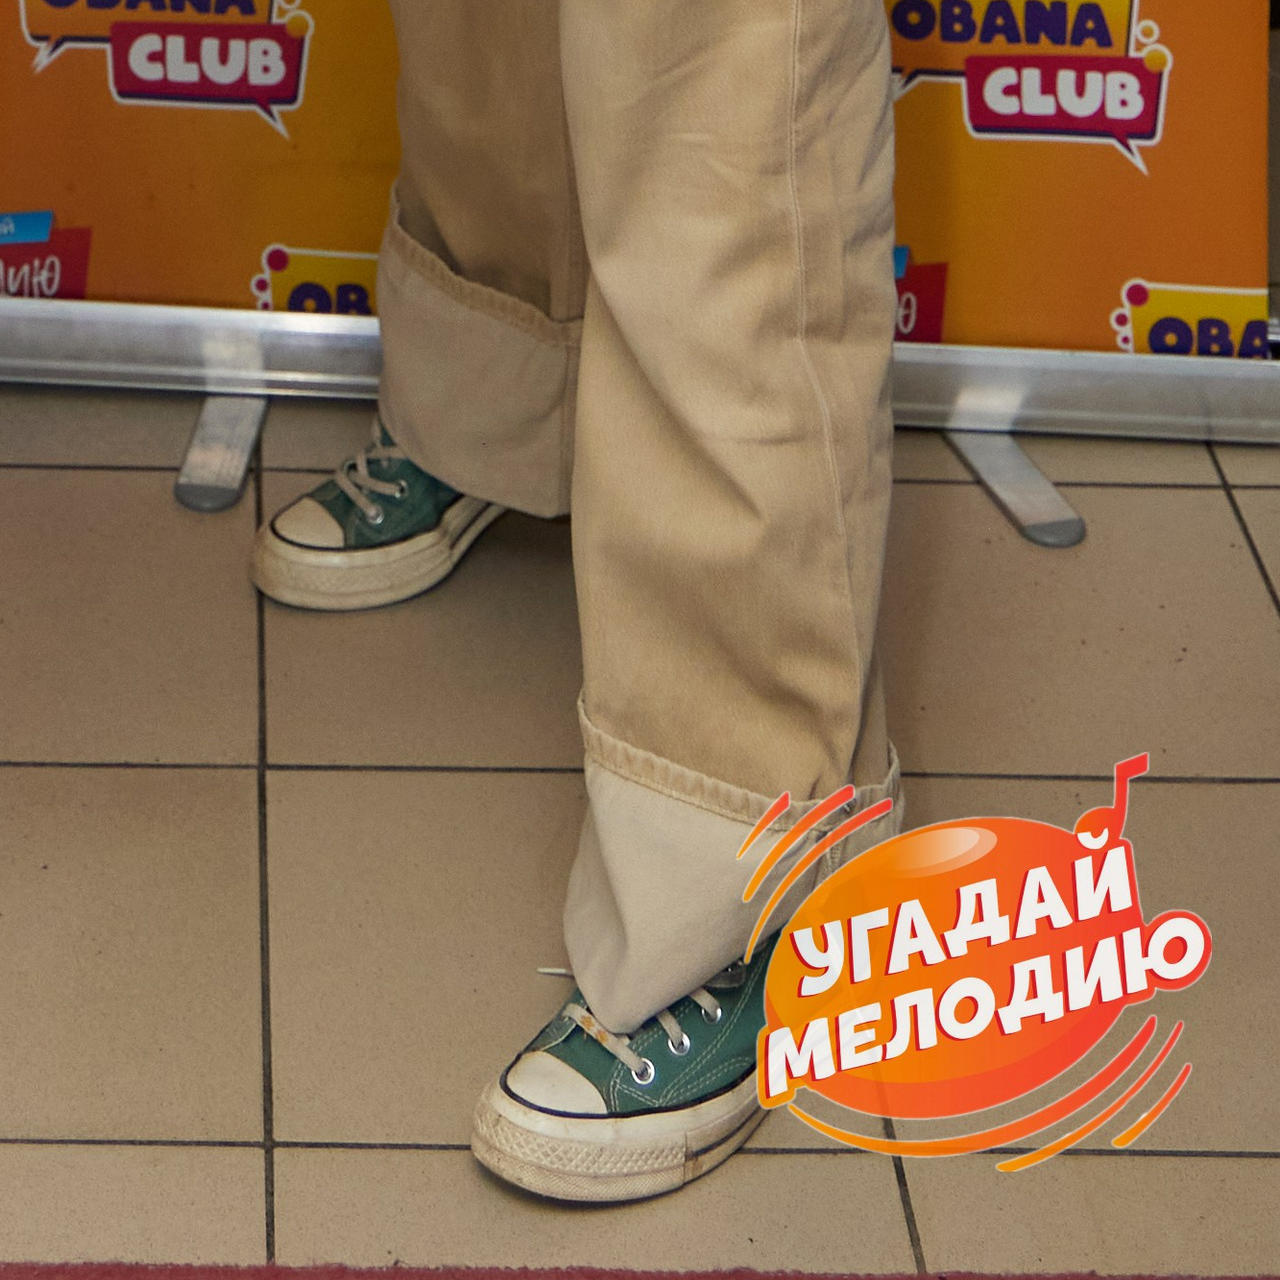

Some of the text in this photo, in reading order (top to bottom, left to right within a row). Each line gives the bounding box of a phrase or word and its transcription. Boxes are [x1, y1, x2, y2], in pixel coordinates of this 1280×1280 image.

[128, 35, 287, 87] CLUB
[983, 67, 1145, 120] CLUB
[1148, 317, 1269, 358] OBA
